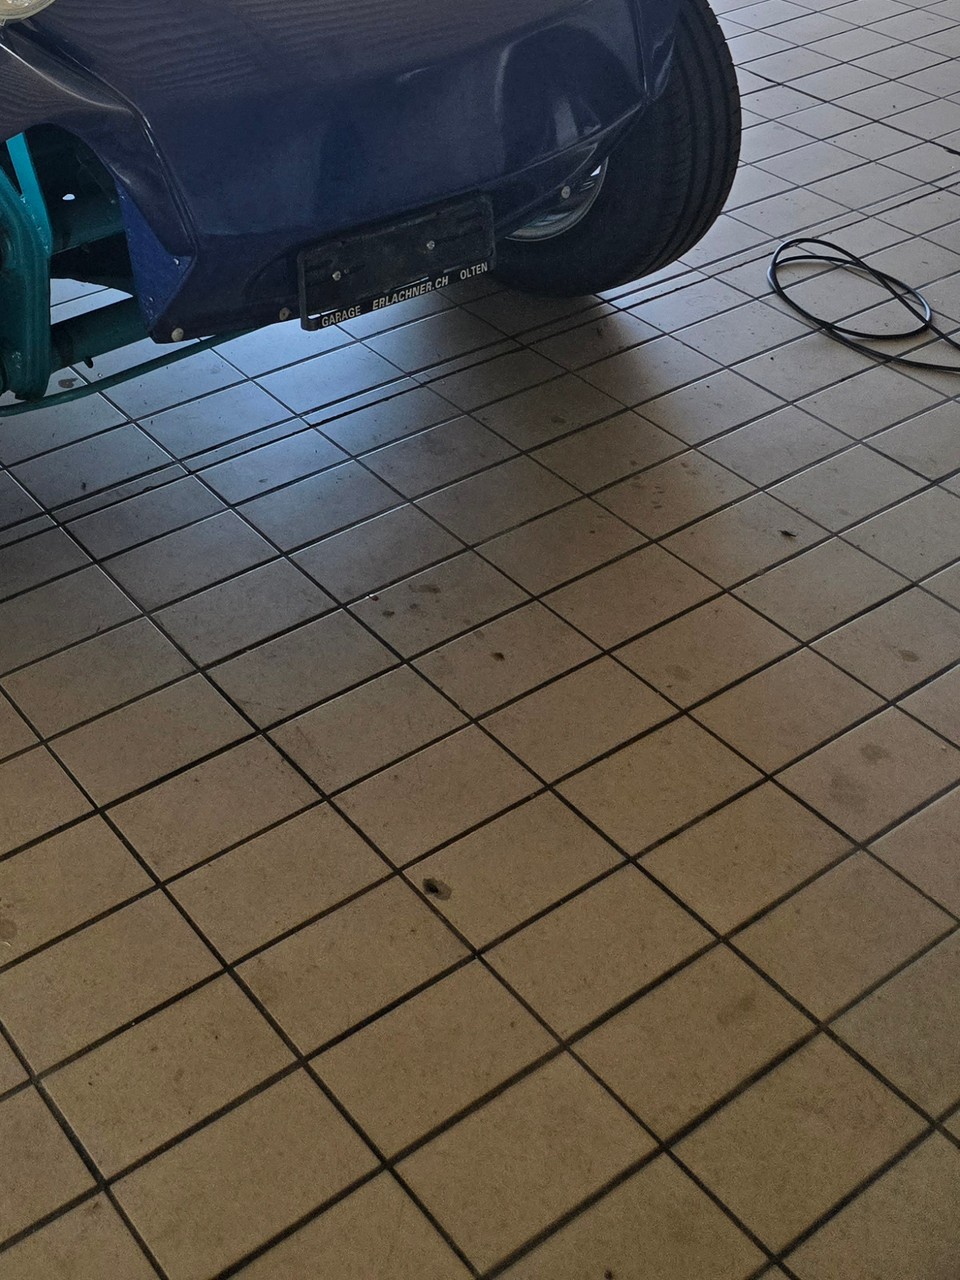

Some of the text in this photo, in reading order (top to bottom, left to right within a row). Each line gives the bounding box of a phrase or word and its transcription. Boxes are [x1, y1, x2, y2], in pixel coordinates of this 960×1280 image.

[321, 262, 488, 328] GARAGE ERLACHNER.CH OLTEN
